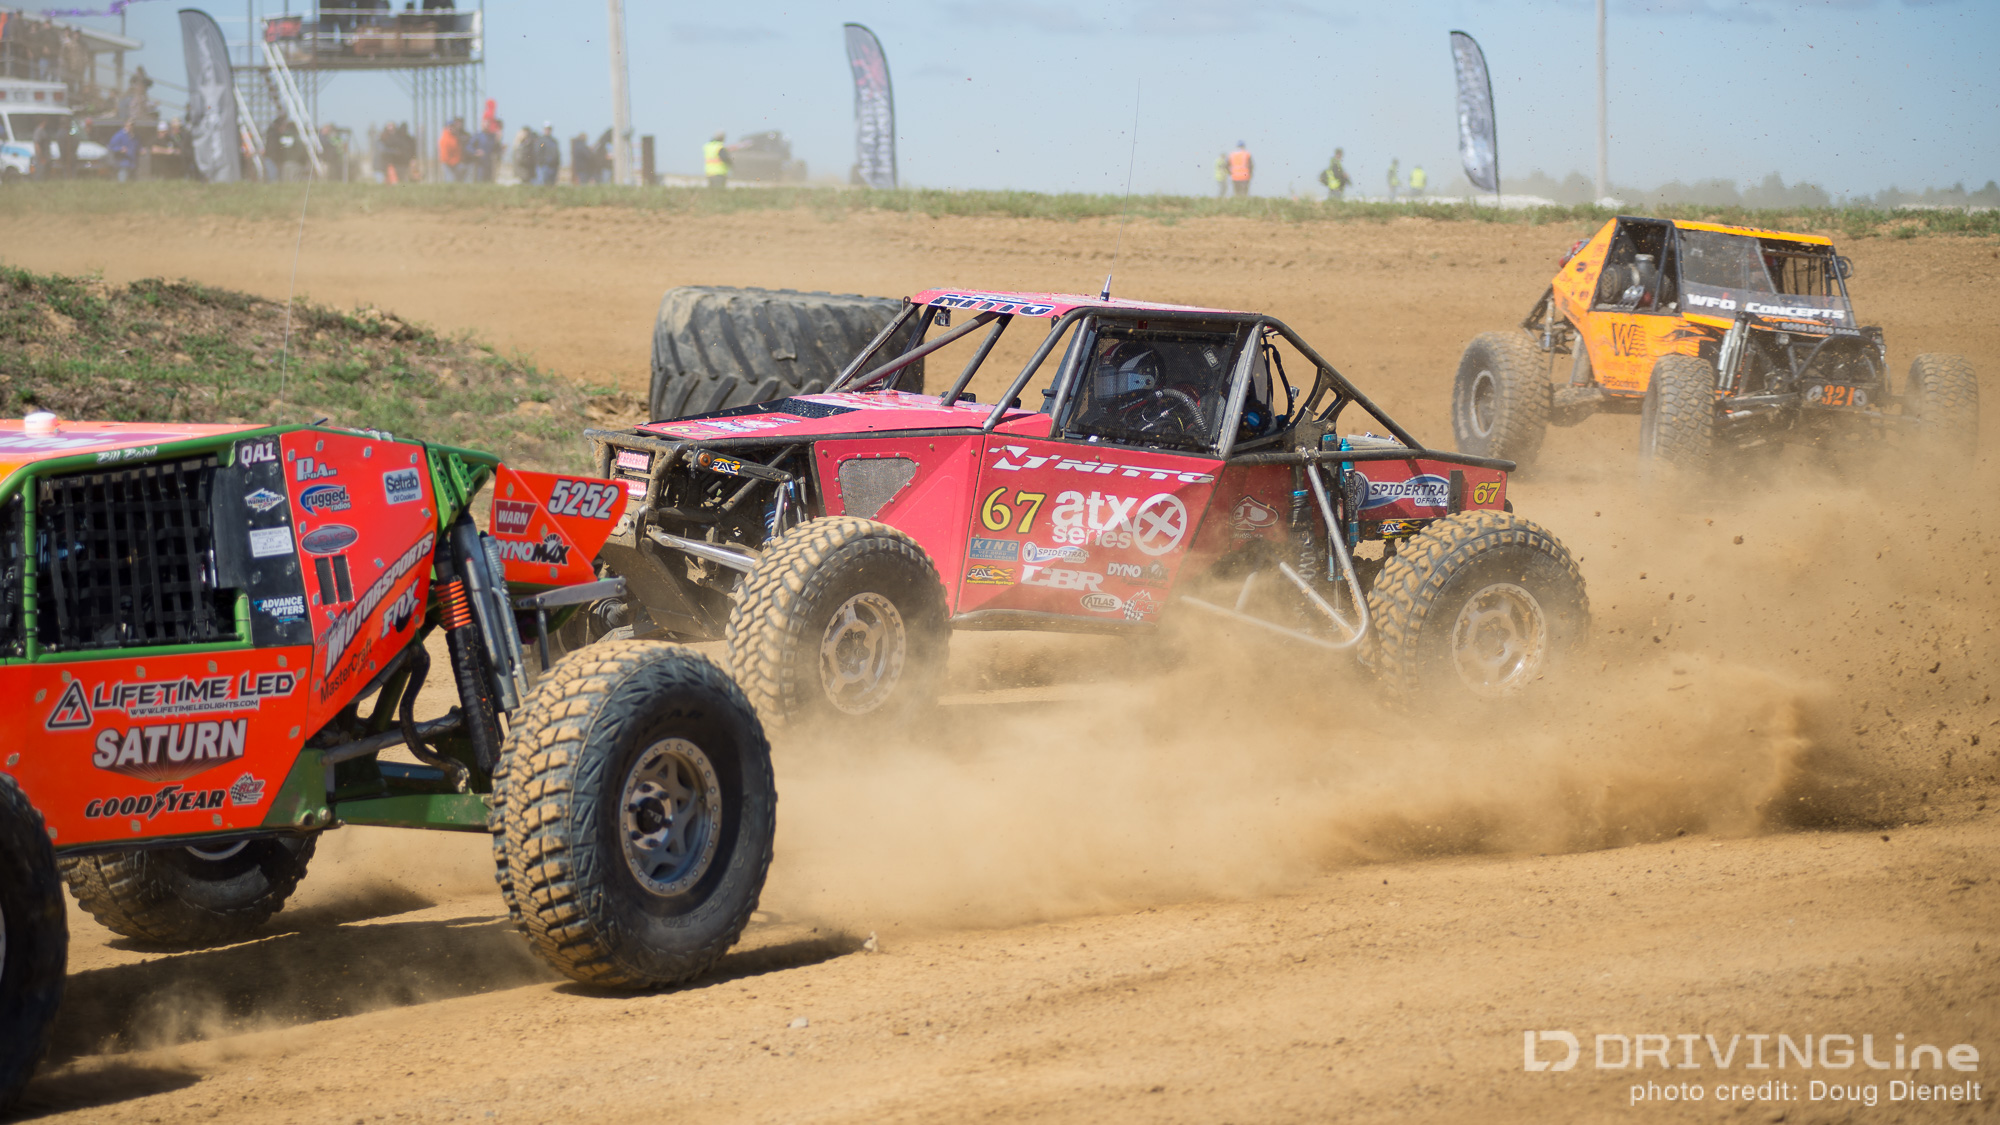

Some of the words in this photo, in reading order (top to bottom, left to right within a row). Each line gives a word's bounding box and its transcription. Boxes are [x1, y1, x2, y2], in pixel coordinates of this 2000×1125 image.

[929, 293, 1056, 316] NITTO
[1821, 385, 1855, 406] 321
[97, 450, 121, 464] Bill
[123, 445, 158, 460] Baird
[241, 442, 277, 467] QA1
[709, 461, 739, 474] PAC
[1054, 460, 1215, 484] NITTO
[386, 473, 419, 494] Setrab
[1473, 482, 1502, 504] 67
[331, 502, 351, 512] radios
[548, 479, 619, 520] 5252
[980, 486, 1047, 534] 67
[498, 510, 529, 525] WARN
[1051, 490, 1139, 532] atx
[1052, 525, 1133, 549] series
[1376, 523, 1402, 533] PAC
[973, 540, 1018, 552] KING
[1037, 548, 1089, 558] SPIDERTRAX
[967, 568, 993, 578] PAC
[261, 596, 303, 609] ADVANCE
[324, 531, 434, 682] MOTORSPORTS
[381, 576, 420, 640] FOX
[1086, 596, 1115, 607] ATLAS
[93, 676, 232, 709] LIFETIME
[239, 671, 295, 696] LED
[130, 700, 258, 717] WWW.LIFETIMELEDLIGHTS.COM
[93, 718, 248, 769] SATURN
[85, 785, 226, 819] GOODYEAR
